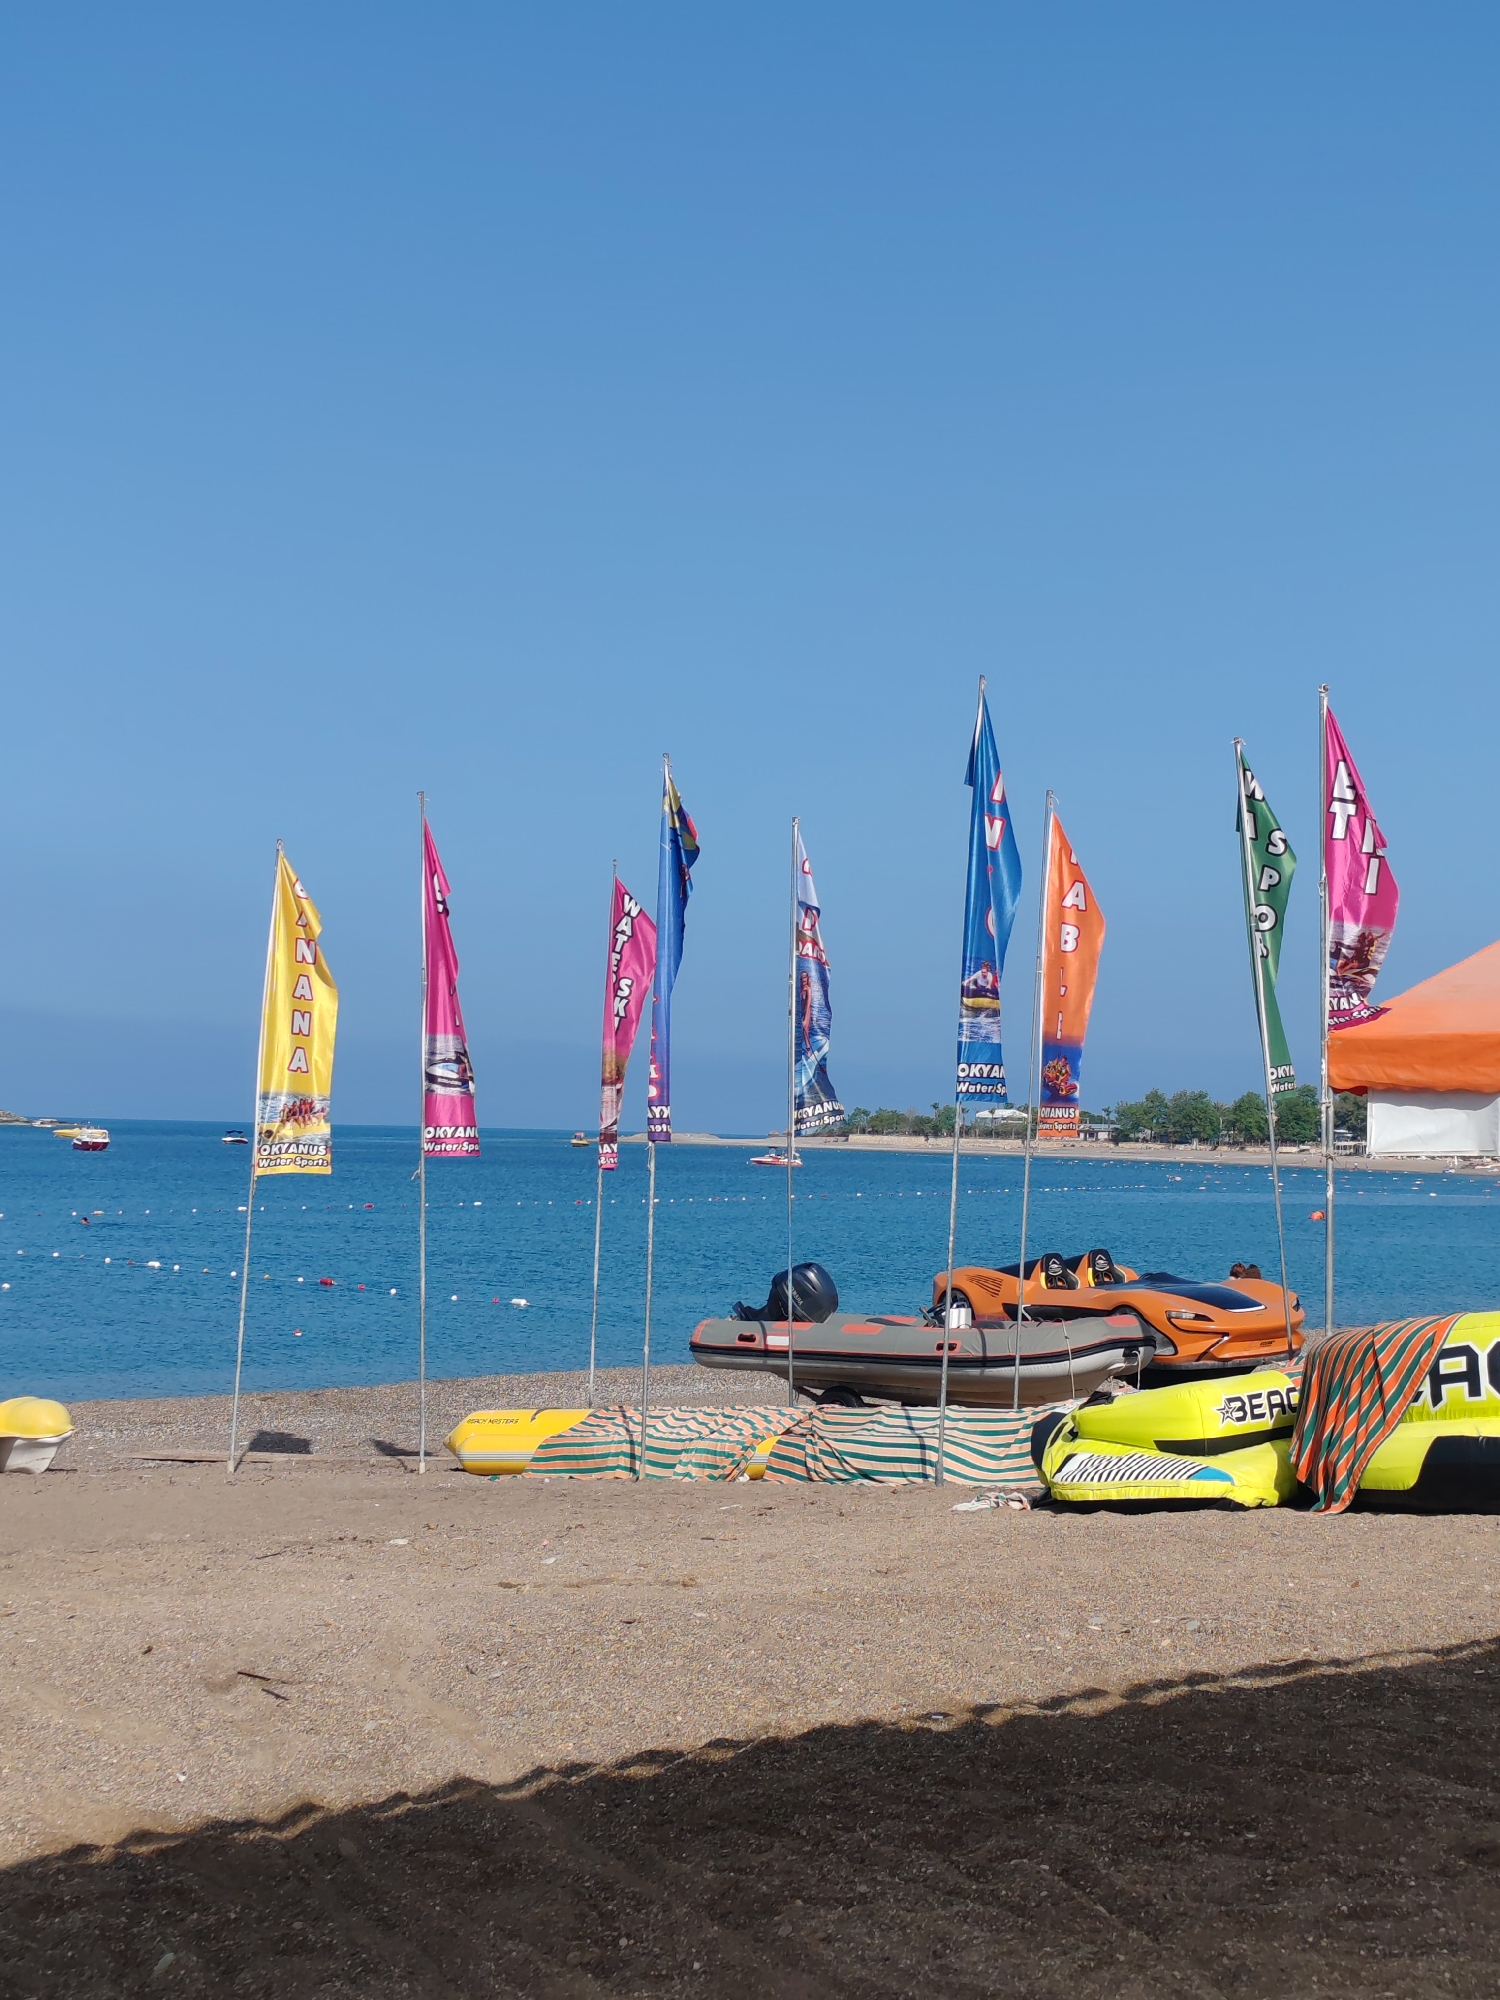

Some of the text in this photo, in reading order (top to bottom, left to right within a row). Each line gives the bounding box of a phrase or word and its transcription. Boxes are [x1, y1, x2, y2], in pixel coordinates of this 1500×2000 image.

[259, 1143, 328, 1157] OKYANUS
[257, 1155, 329, 1169] Water Sports
